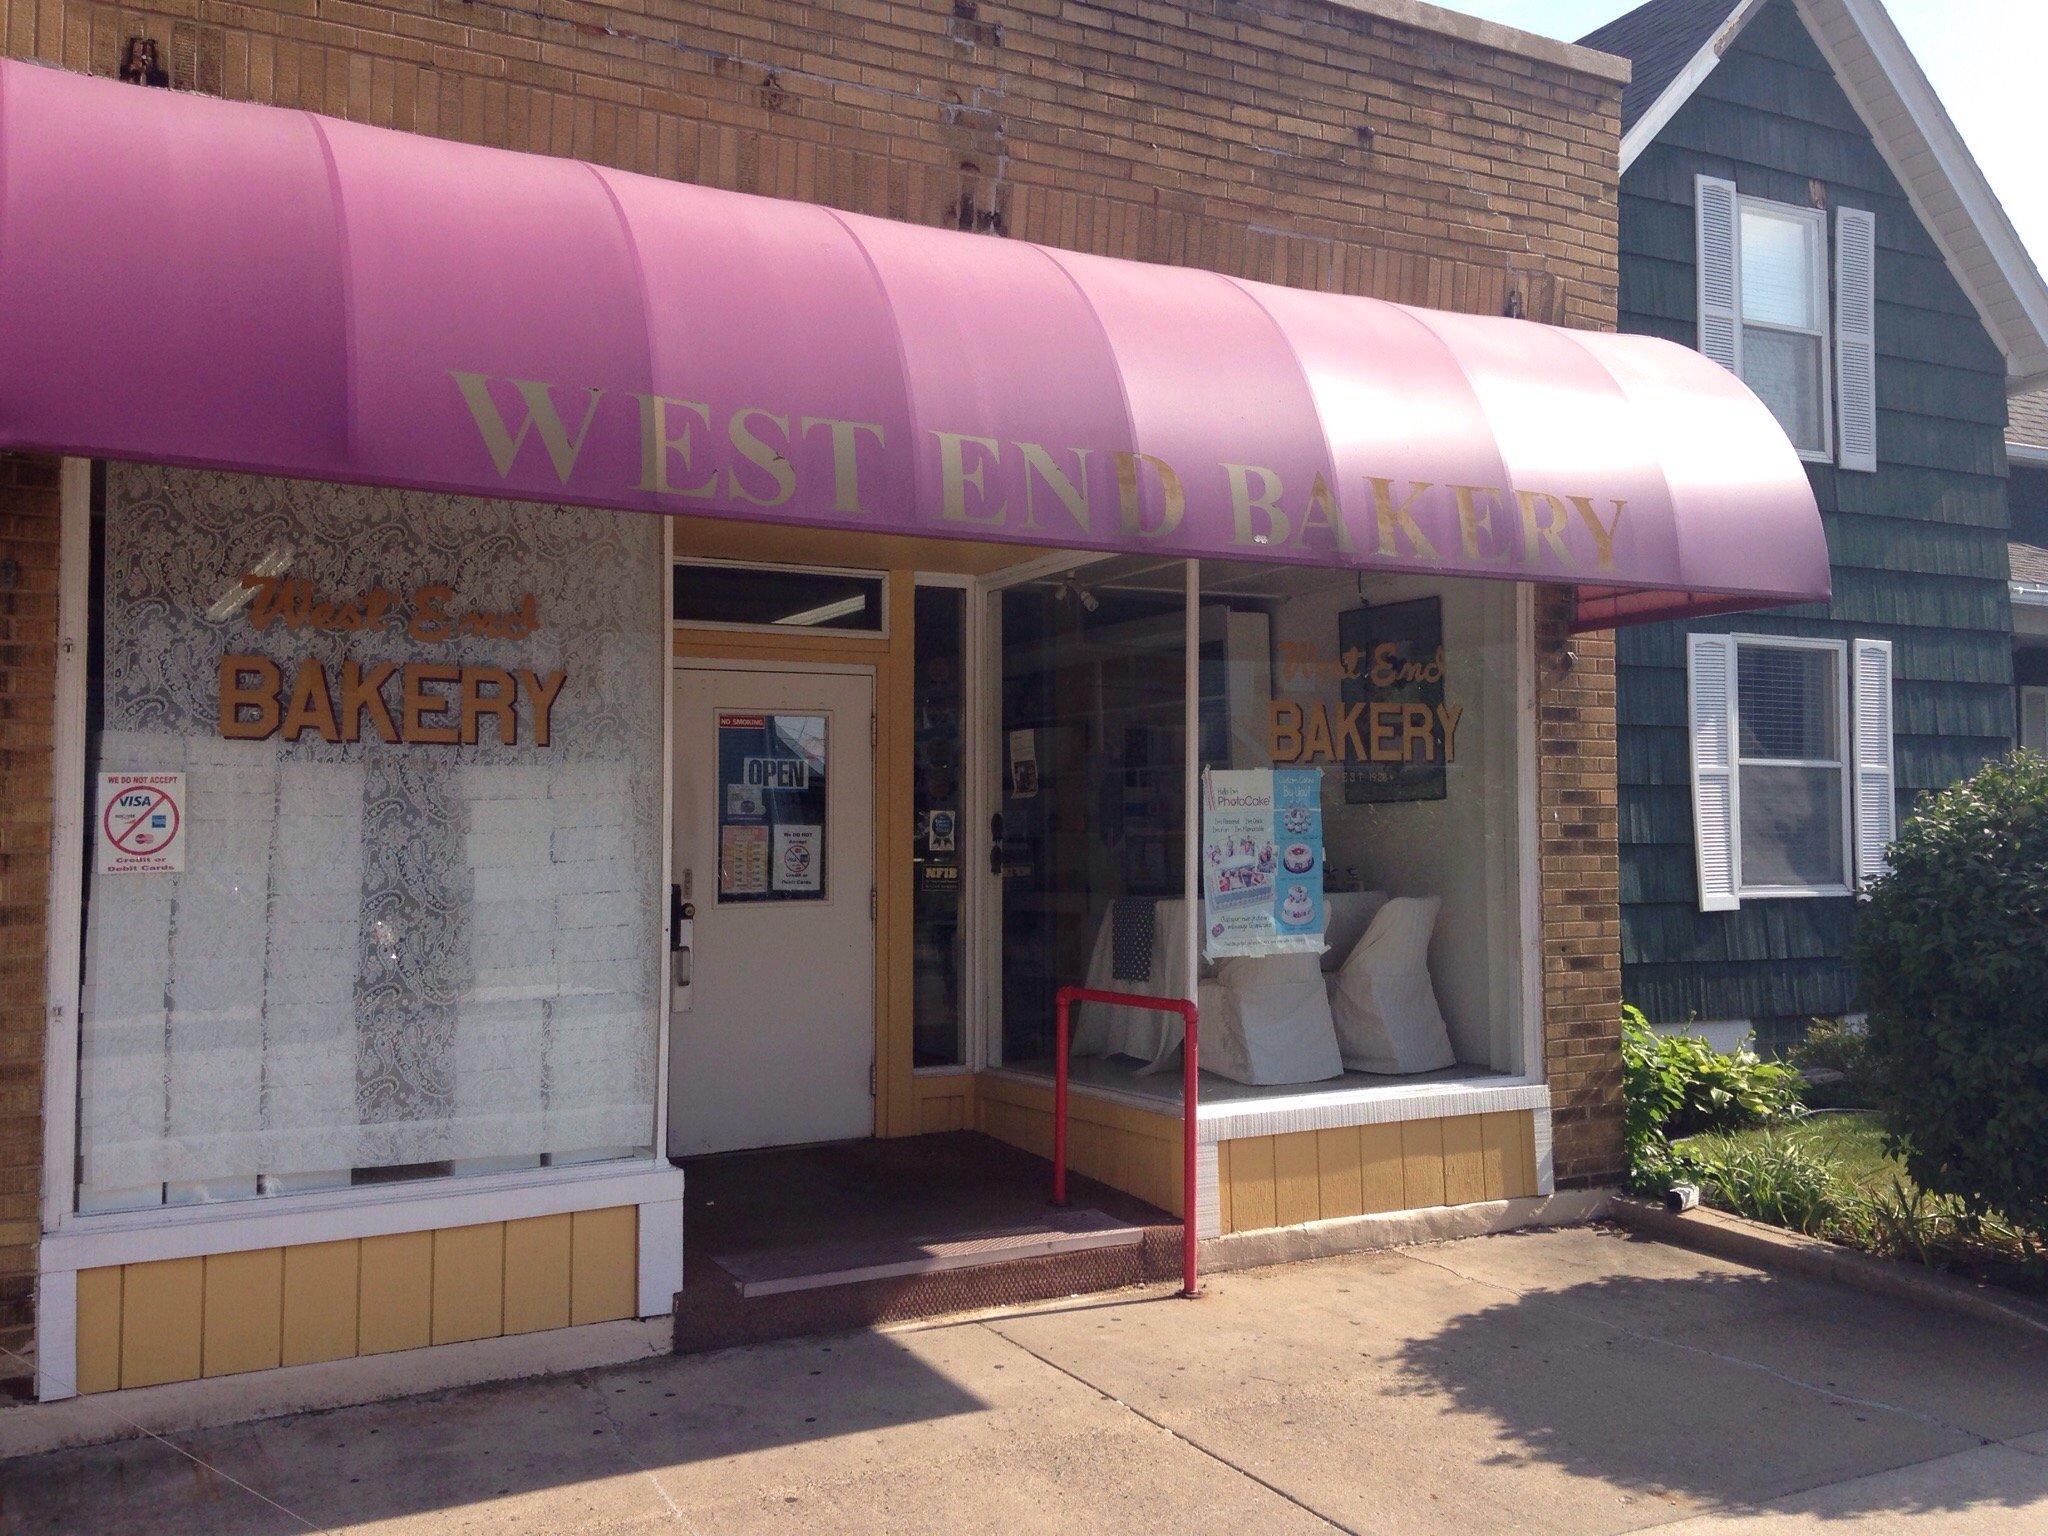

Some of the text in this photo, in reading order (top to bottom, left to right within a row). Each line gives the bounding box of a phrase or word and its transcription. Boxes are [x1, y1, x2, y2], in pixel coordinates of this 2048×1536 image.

[448, 370, 1628, 571] WEST END BAKERY
[242, 575, 540, 644] West End
[1276, 641, 1444, 687] West End
[217, 653, 567, 748] BAKERY
[721, 718, 763, 727] NO SMOKING
[1267, 699, 1463, 763] BAKERY
[108, 776, 178, 784] WE DO NOT ACCEPT
[749, 760, 804, 787] OPEN
[119, 796, 151, 807] VISA
[1218, 796, 1270, 807] PhotoCake
